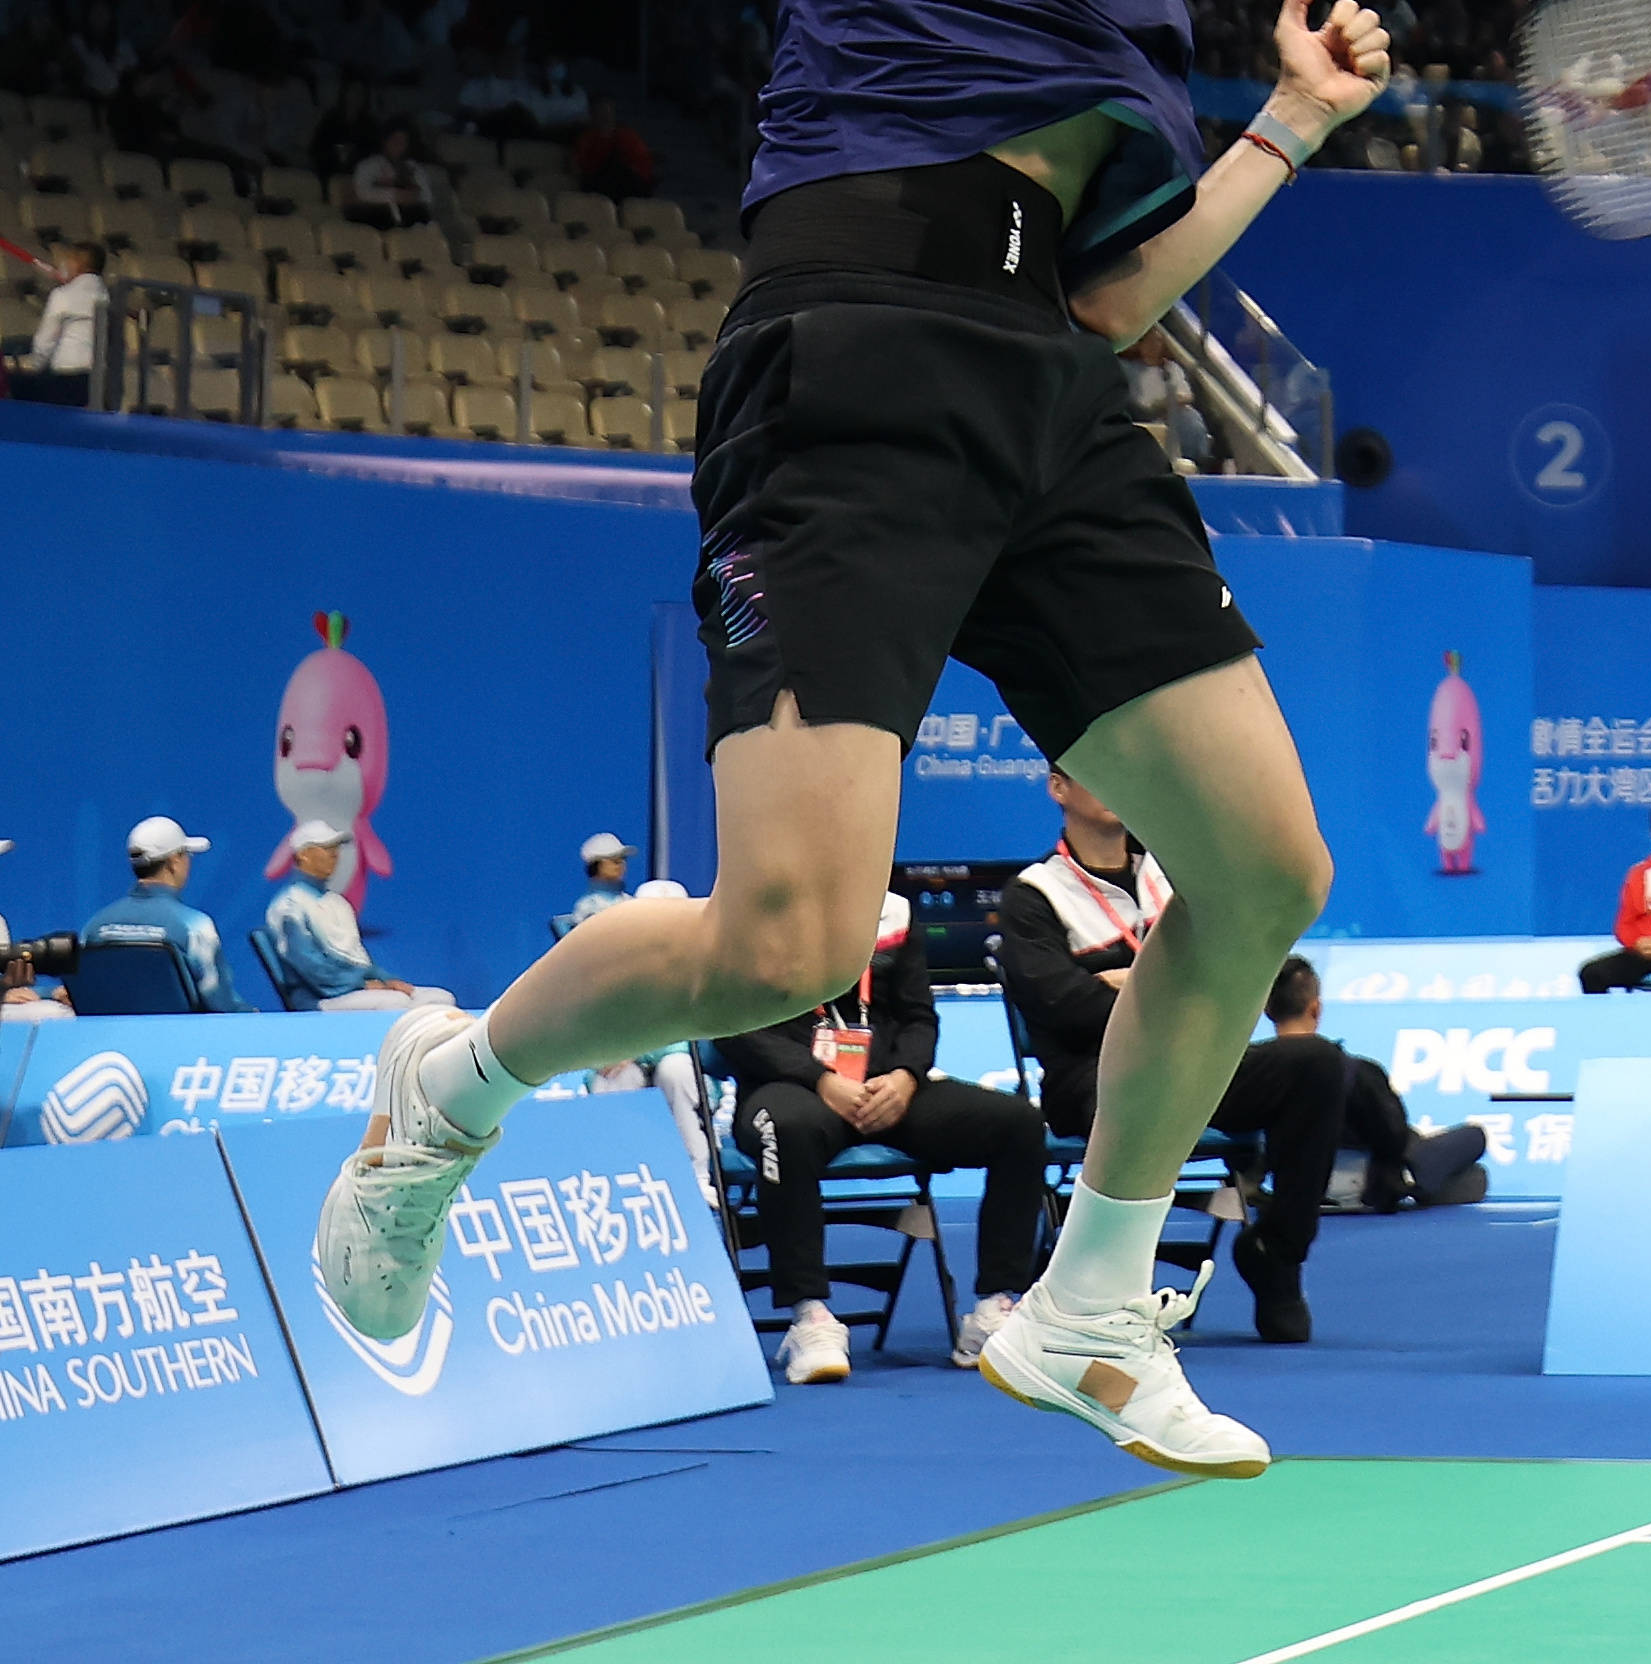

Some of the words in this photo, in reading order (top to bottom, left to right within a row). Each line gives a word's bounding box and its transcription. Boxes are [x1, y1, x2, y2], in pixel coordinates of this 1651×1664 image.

[1002, 228, 1021, 274] YONEX
[1536, 420, 1586, 488] 2
[170, 1055, 377, 1113] 中国移动
[1391, 1026, 1557, 1094] PICC
[448, 1163, 689, 1282] 中国移动
[0, 1248, 239, 1354] 国南方航空
[486, 1291, 602, 1356] China
[591, 1266, 717, 1338] Mobile
[0, 1363, 67, 1421] INA
[65, 1332, 259, 1409] SOUTHERN
